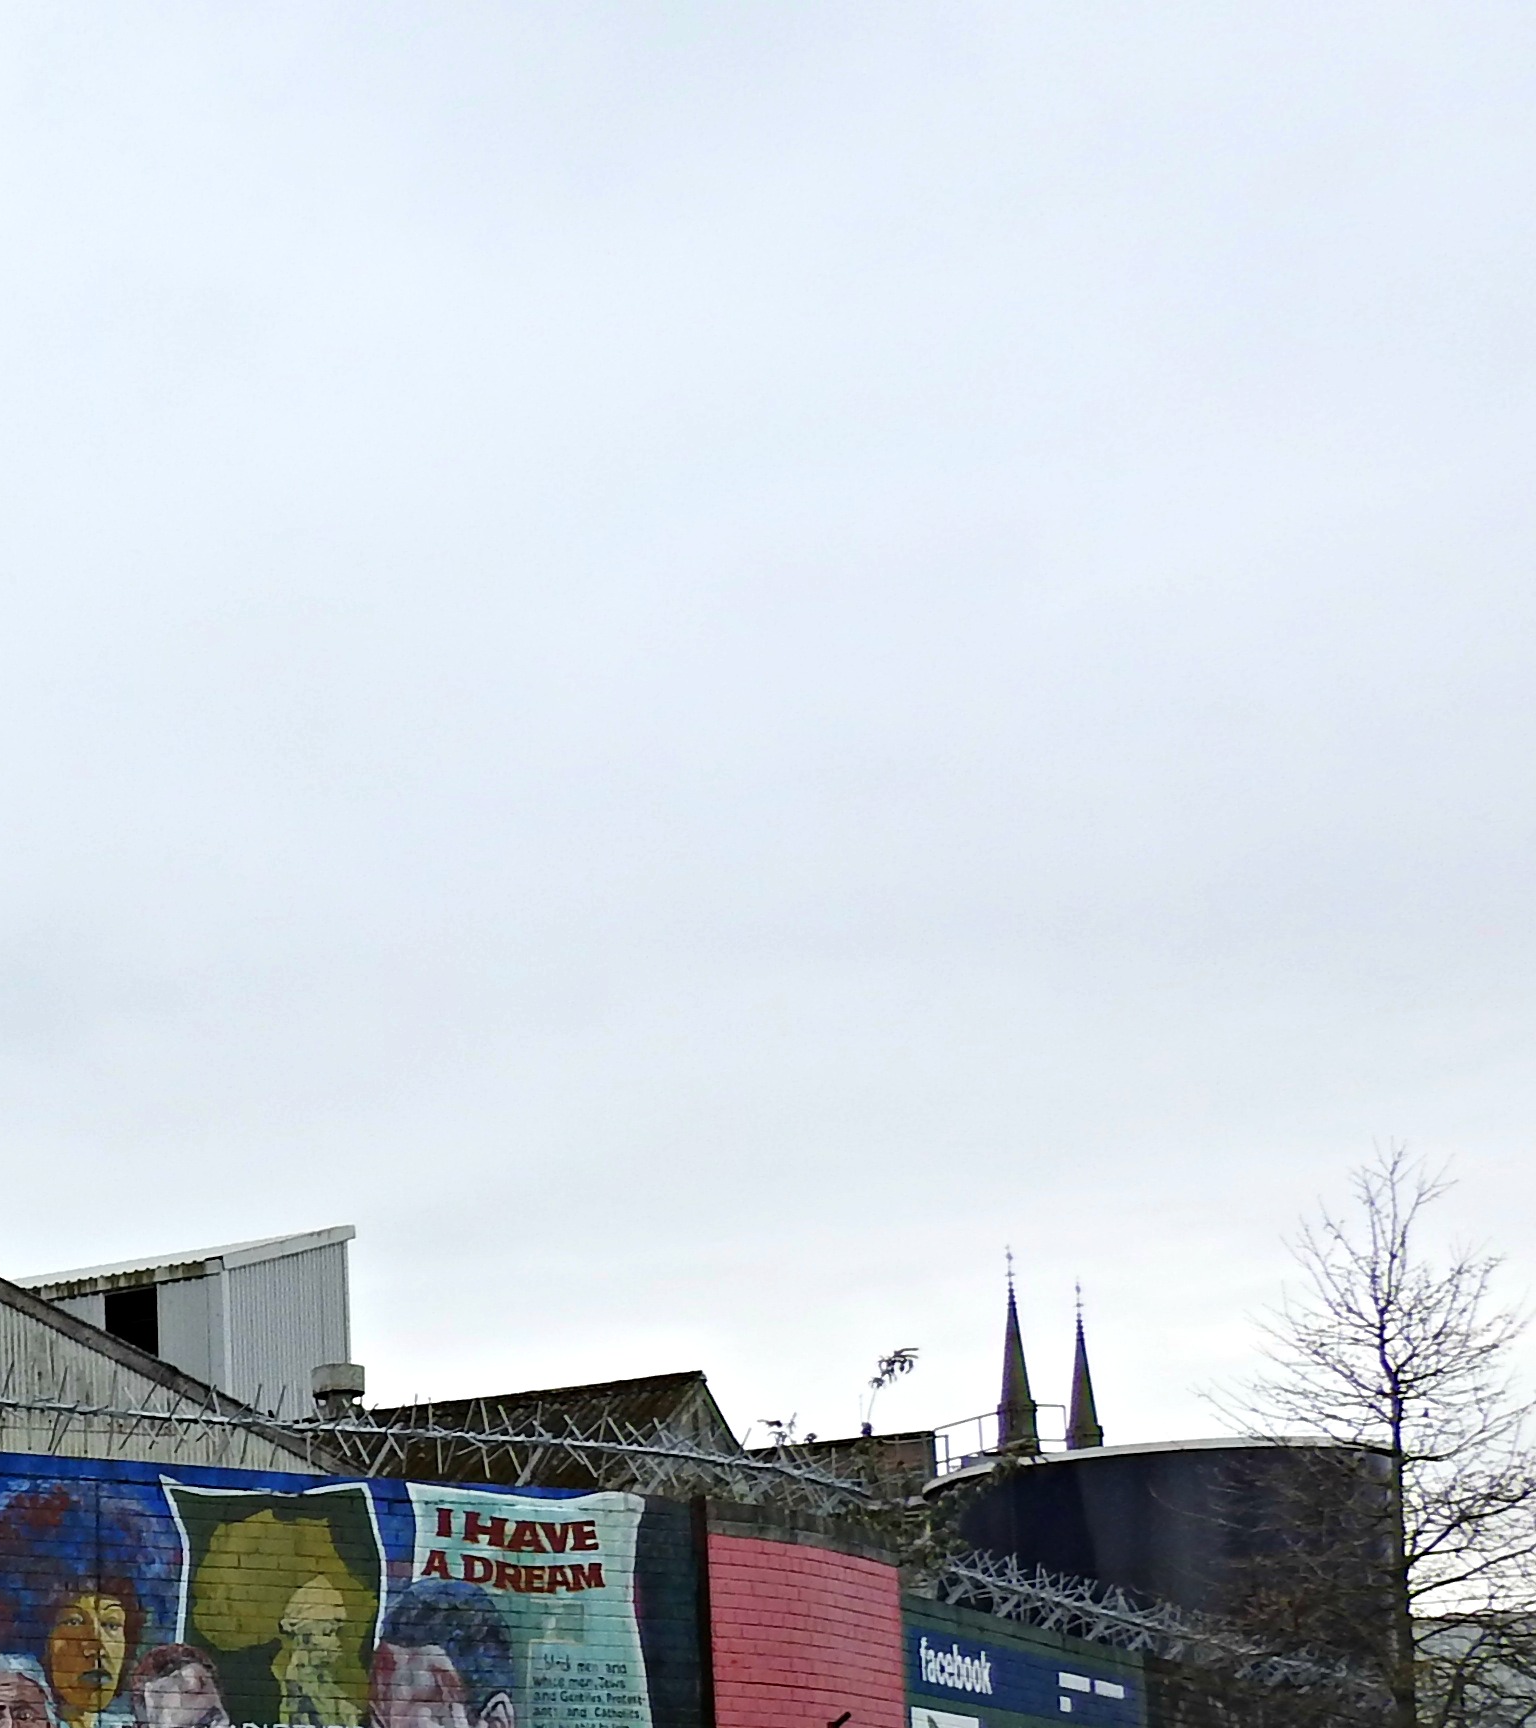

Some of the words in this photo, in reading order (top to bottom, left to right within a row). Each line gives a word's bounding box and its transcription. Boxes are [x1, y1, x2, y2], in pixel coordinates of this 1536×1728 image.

[436, 1508, 453, 1538] I
[463, 1510, 599, 1553] HAVE
[421, 1550, 453, 1580] A
[460, 1553, 606, 1594] DREAM
[919, 1636, 993, 1695] facebook
